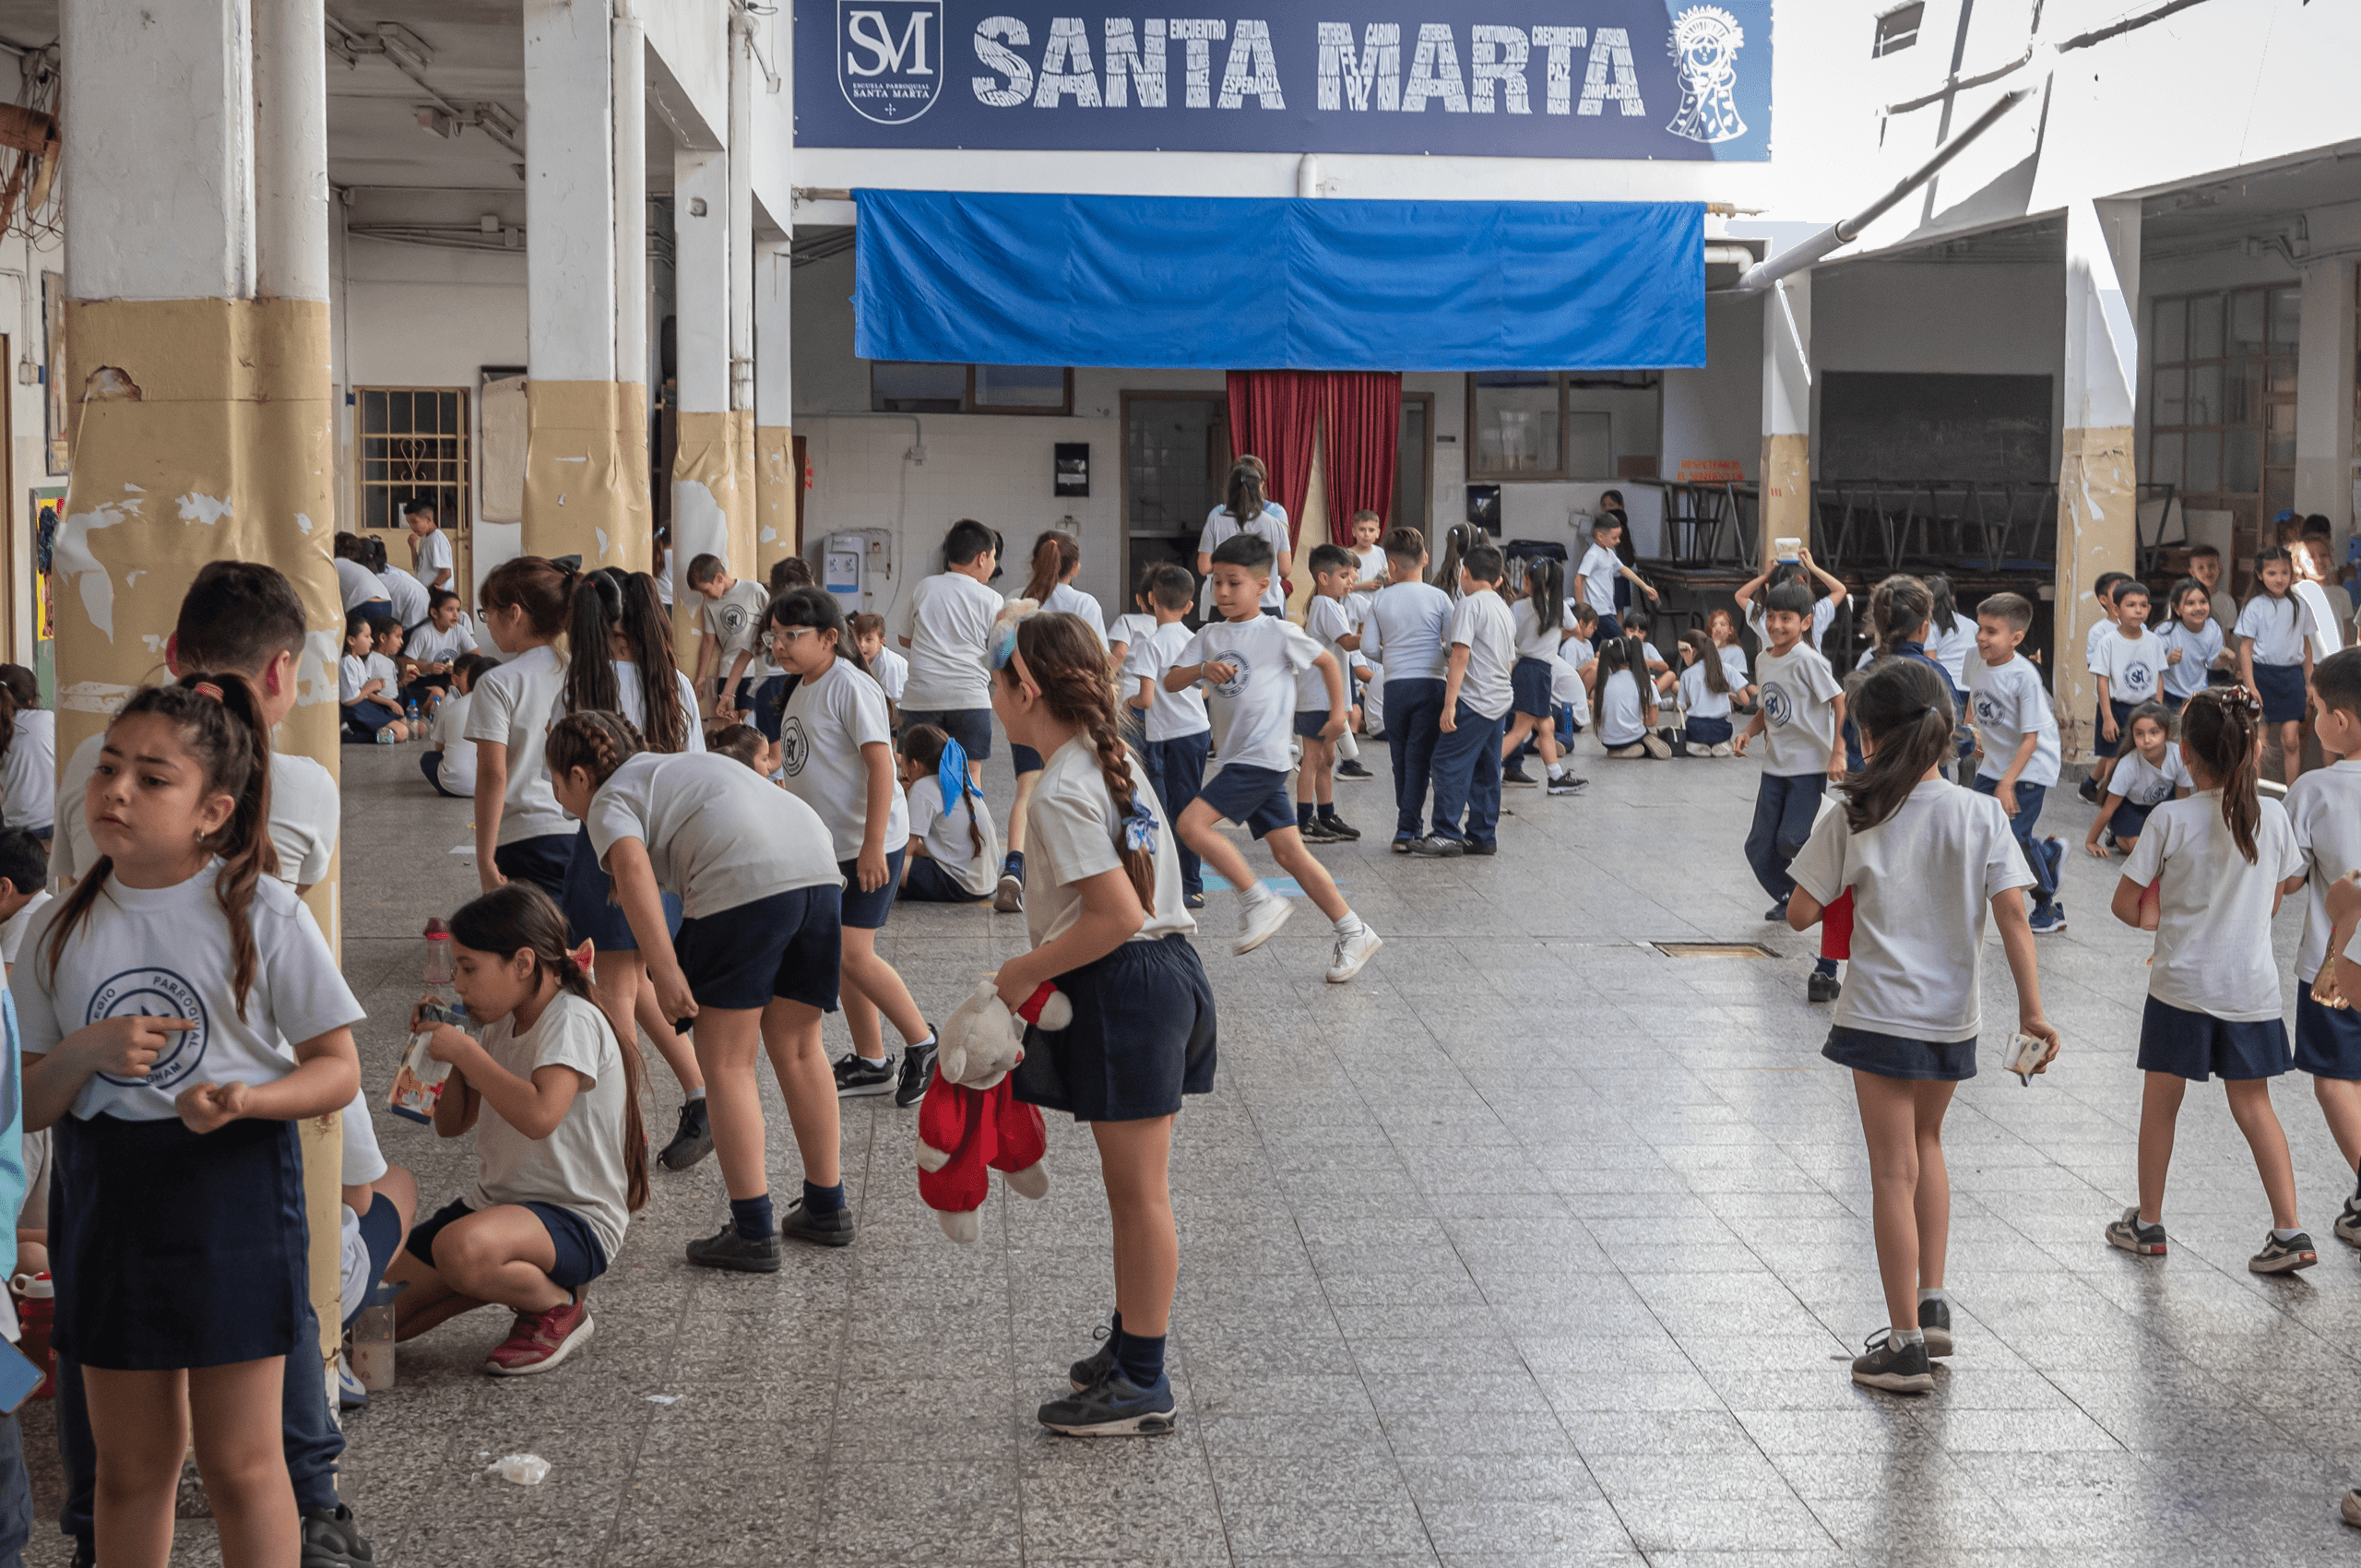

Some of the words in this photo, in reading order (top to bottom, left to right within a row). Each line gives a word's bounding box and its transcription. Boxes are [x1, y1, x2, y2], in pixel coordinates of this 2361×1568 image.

[1169, 18, 1227, 40] ENCUENTRO
[1532, 25, 1588, 48] CRECIMIENTO
[848, 10, 933, 77] SM
[1228, 50, 1250, 63] MI
[1339, 45, 1359, 77] FE
[1548, 45, 1571, 64] AMOR
[972, 16, 1287, 110] SANTA
[1317, 21, 1647, 116] MARTA
[1548, 63, 1571, 81] PAZ
[853, 89, 888, 98] SANTA
[892, 89, 930, 99] MARTA
[1221, 75, 1283, 94] ESPERANZA
[1346, 75, 1373, 111] PAZ
[1472, 77, 1495, 97] DIOS
[1472, 95, 1495, 113] HOGAR
[1547, 98, 1571, 114] HOGAR
[1619, 98, 1646, 116] LUGAR
